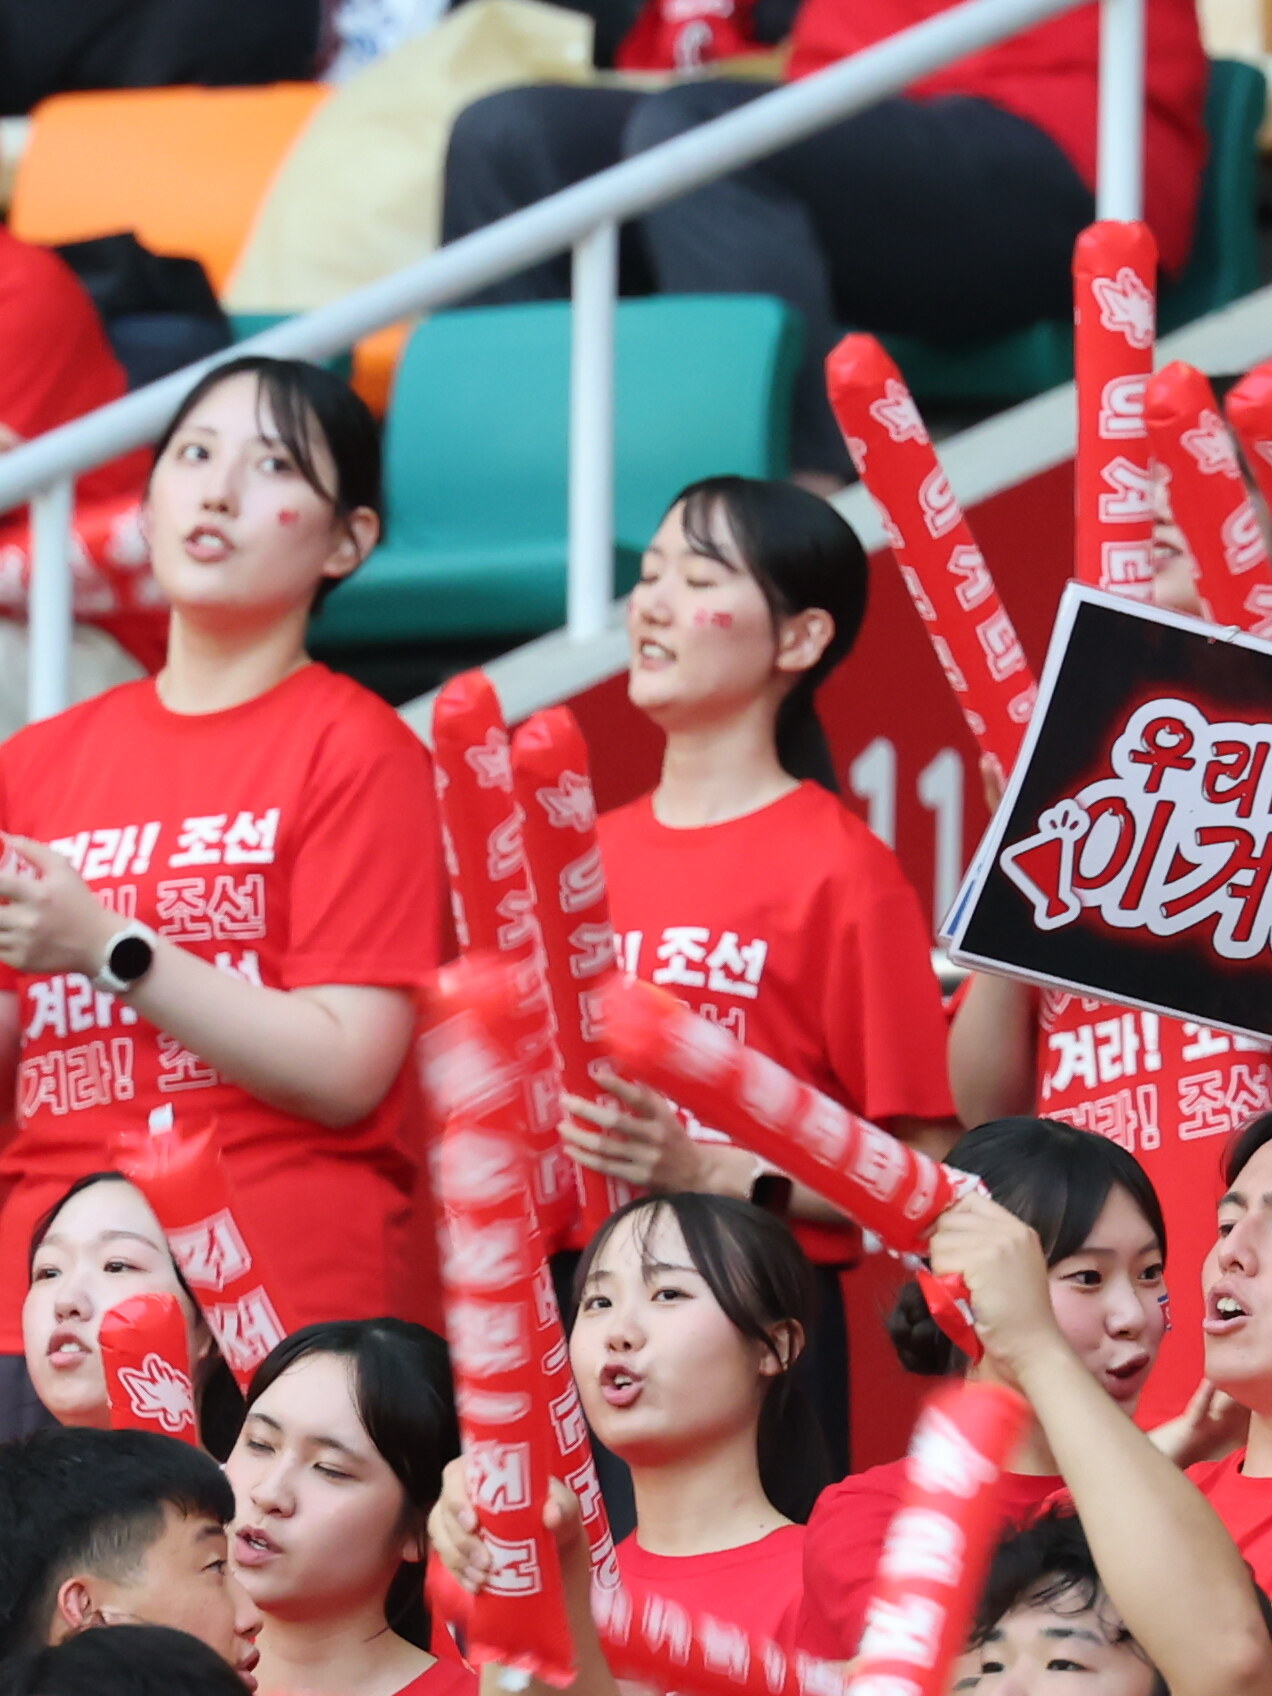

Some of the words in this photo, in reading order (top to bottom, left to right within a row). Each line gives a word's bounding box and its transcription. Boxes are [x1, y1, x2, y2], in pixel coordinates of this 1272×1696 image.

[168, 807, 280, 867] 조선
[156, 873, 266, 942] 조선
[652, 925, 768, 999] 조선
